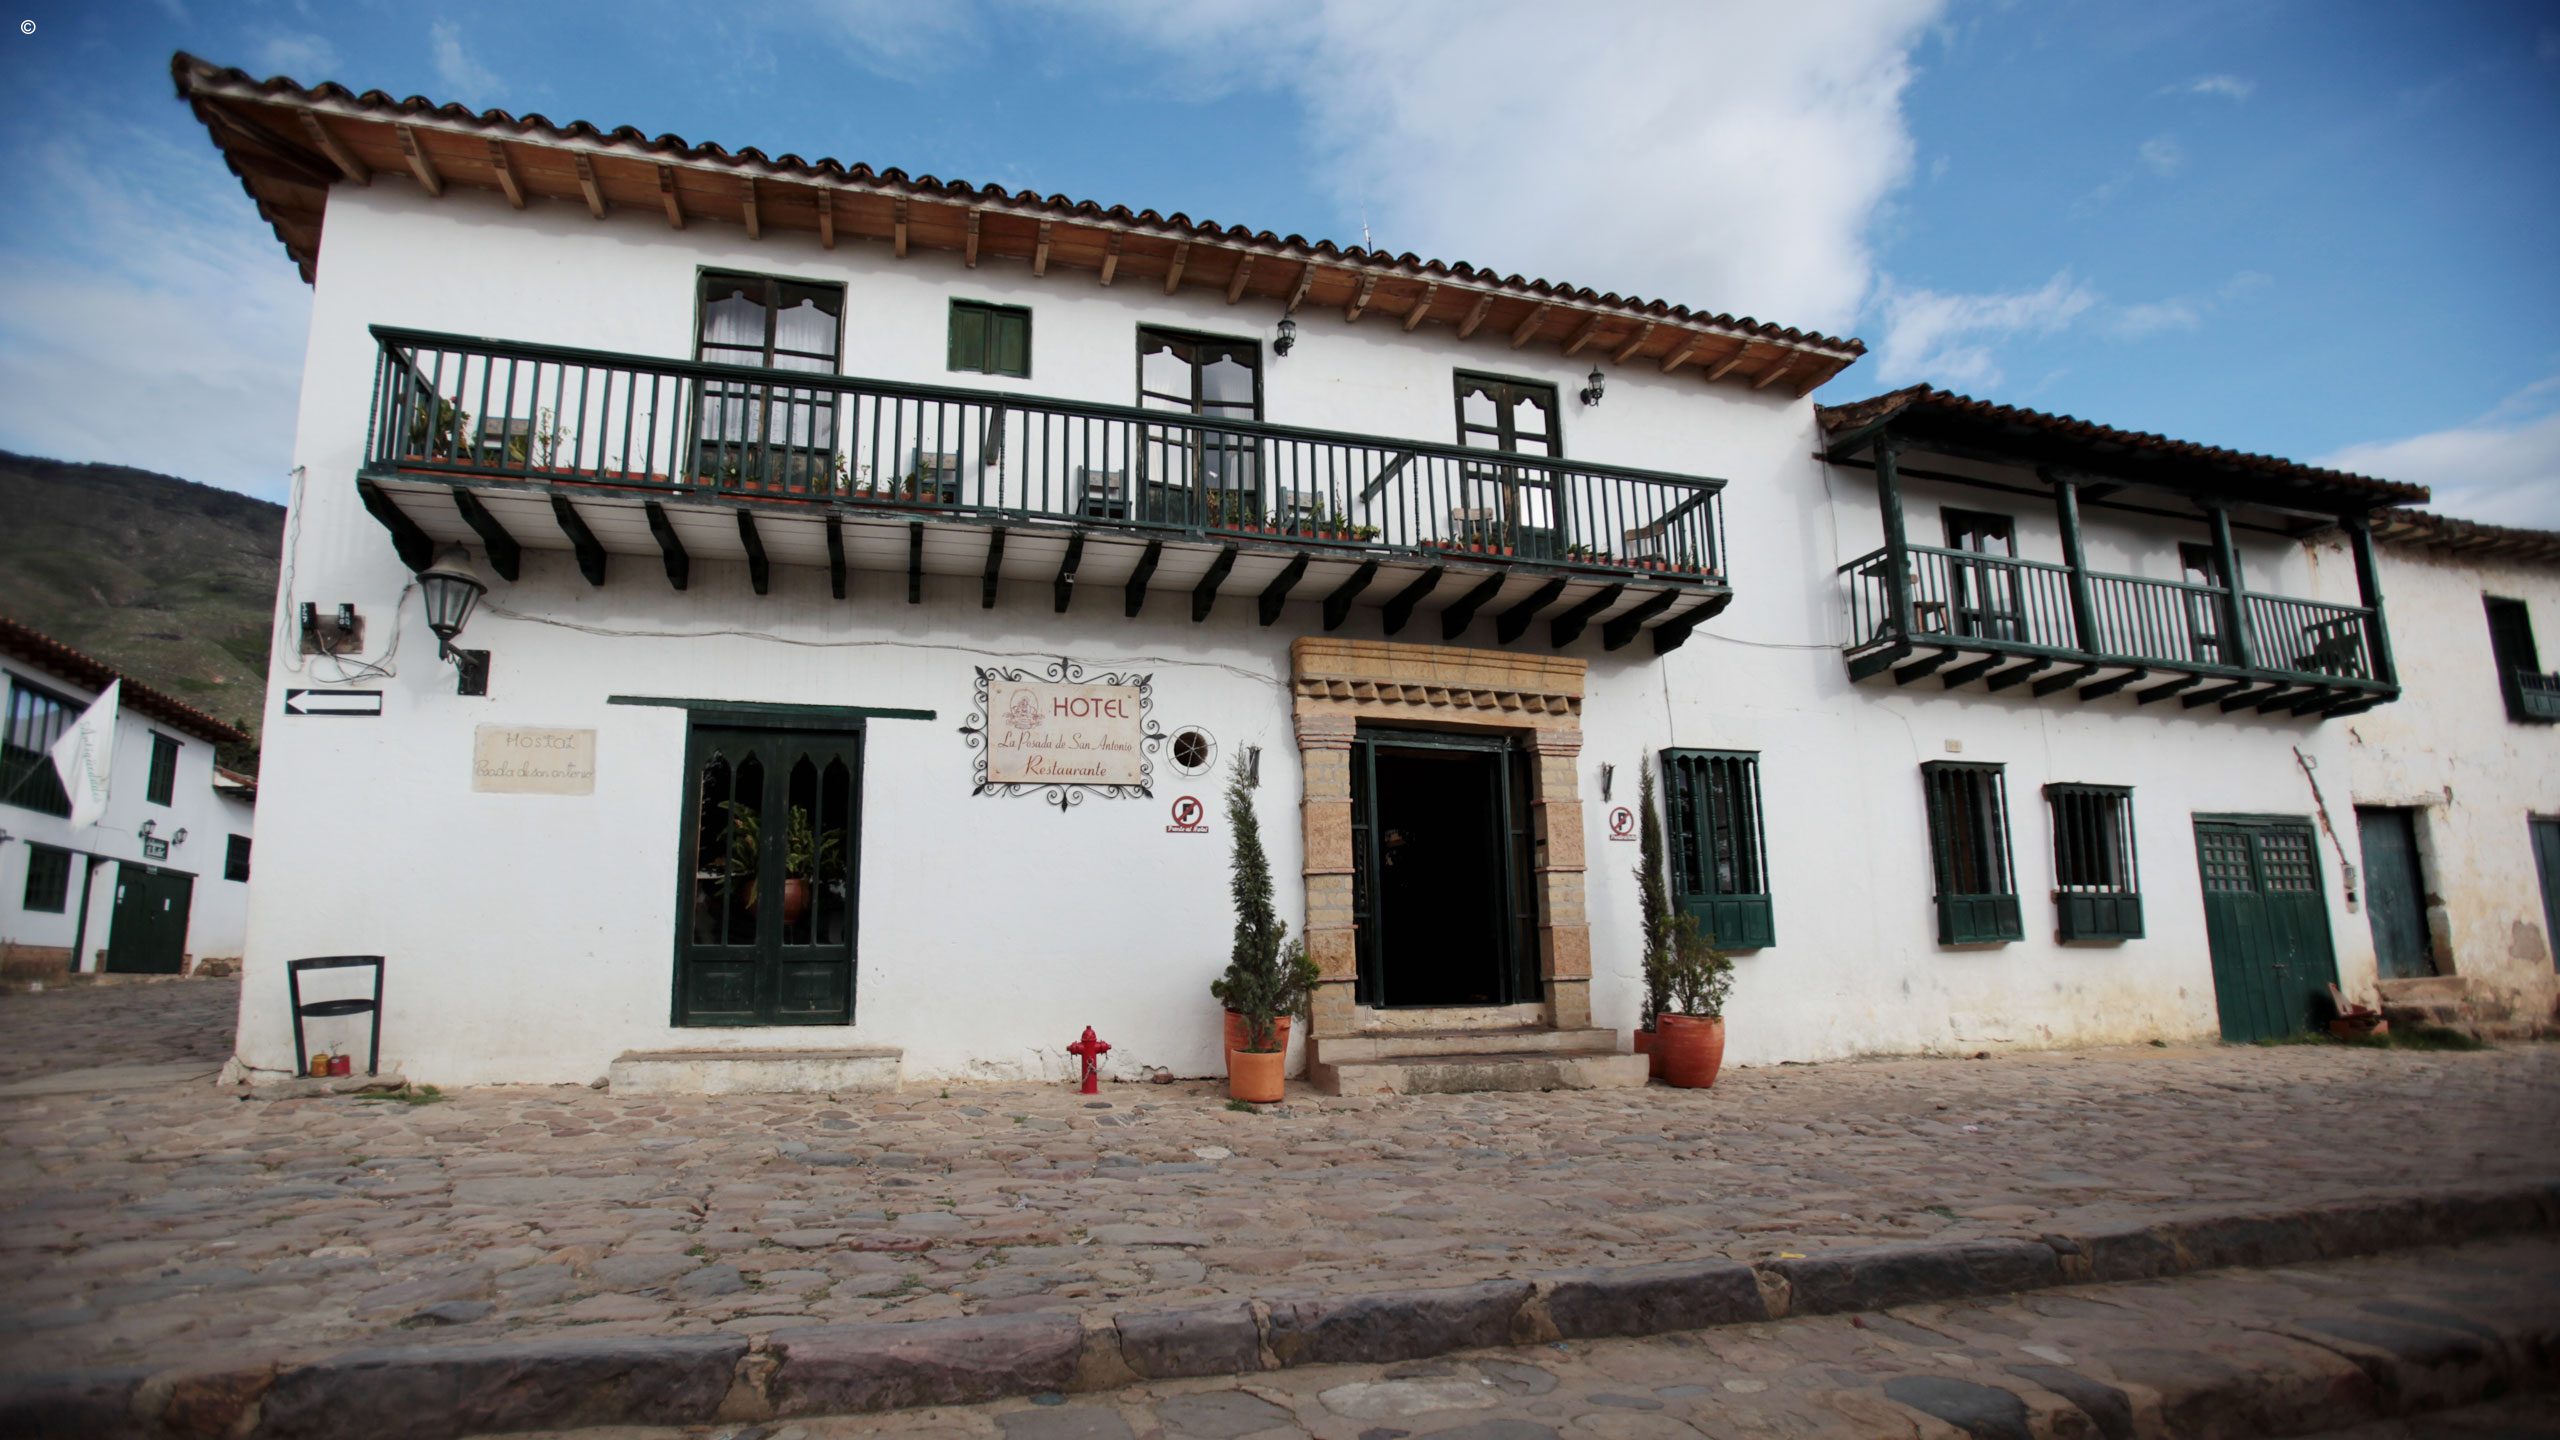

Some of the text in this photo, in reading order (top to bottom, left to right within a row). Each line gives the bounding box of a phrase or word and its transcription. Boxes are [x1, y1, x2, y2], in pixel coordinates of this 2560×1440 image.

[1053, 697, 1129, 719] HOTEL
[998, 730, 1133, 752] La Posada de San Antonio
[1024, 754, 1107, 777] Restaurante
